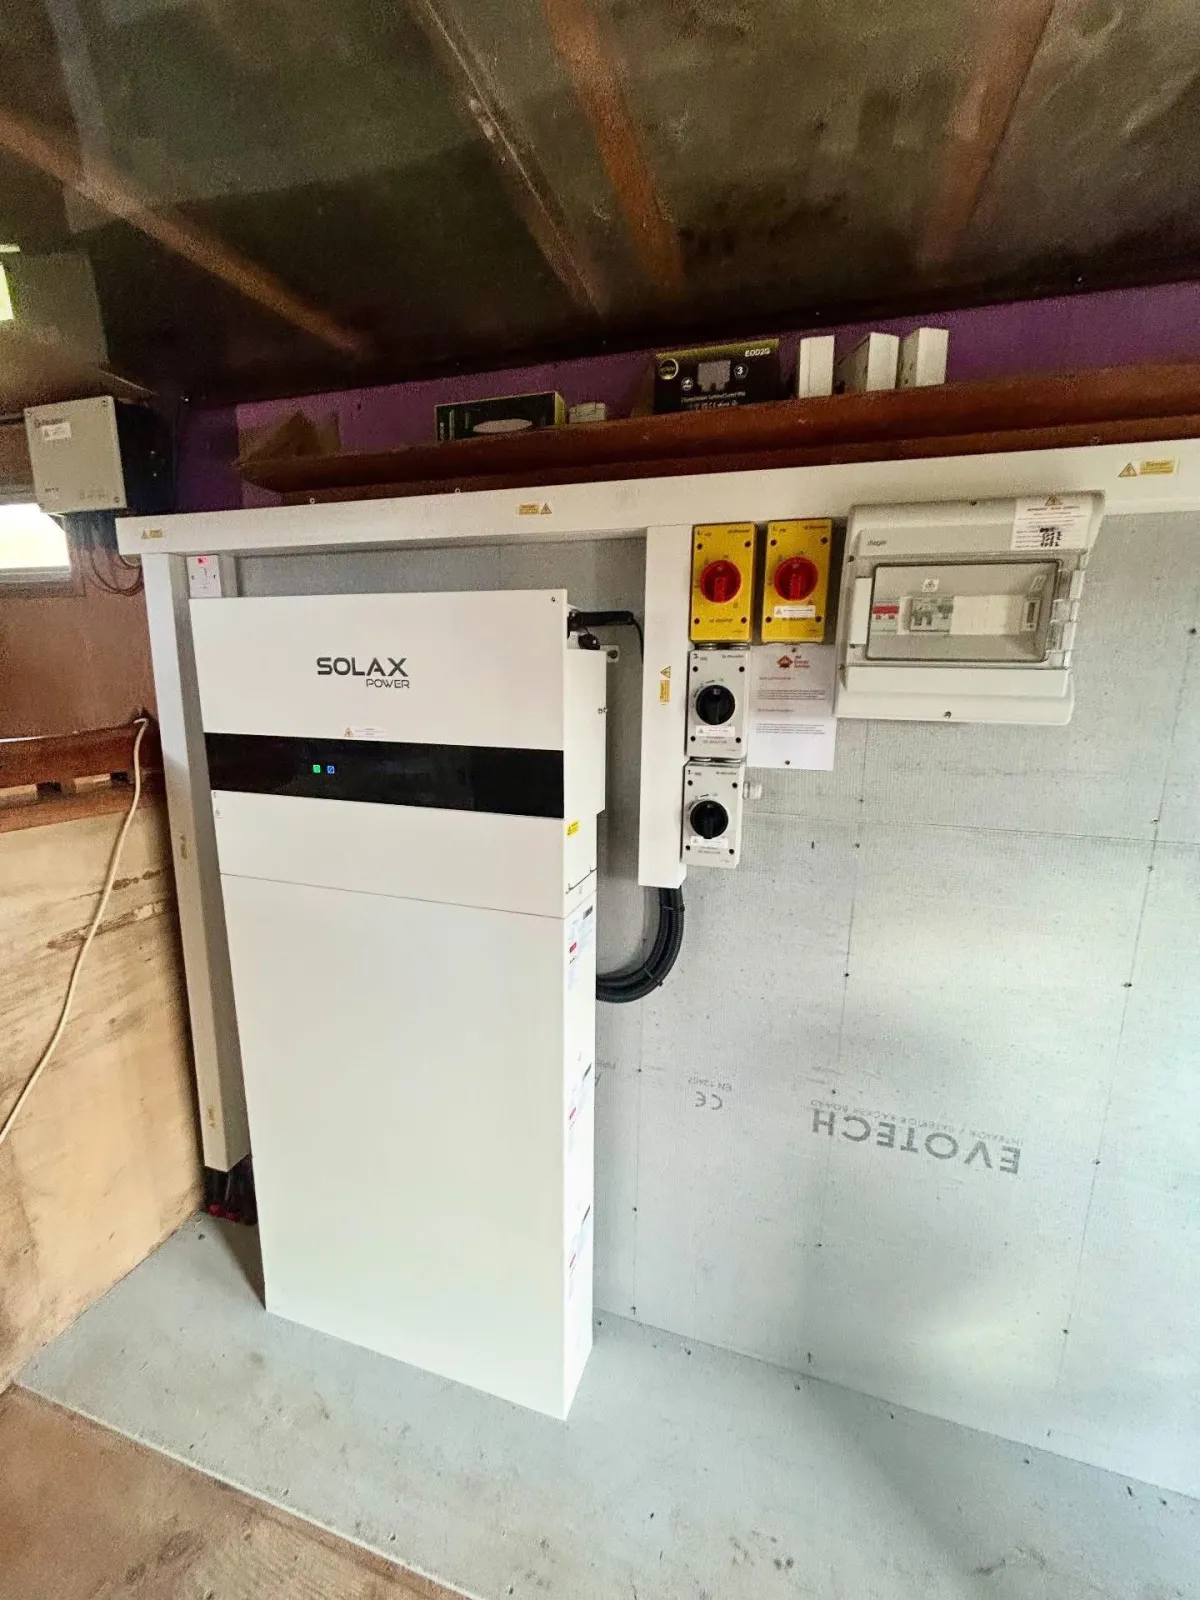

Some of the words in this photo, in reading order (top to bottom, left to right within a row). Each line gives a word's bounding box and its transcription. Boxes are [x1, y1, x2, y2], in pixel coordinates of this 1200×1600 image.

[317, 657, 409, 675] SOLAX
[366, 678, 410, 689] POWER
[812, 1109, 1021, 1175] EVOTECH
